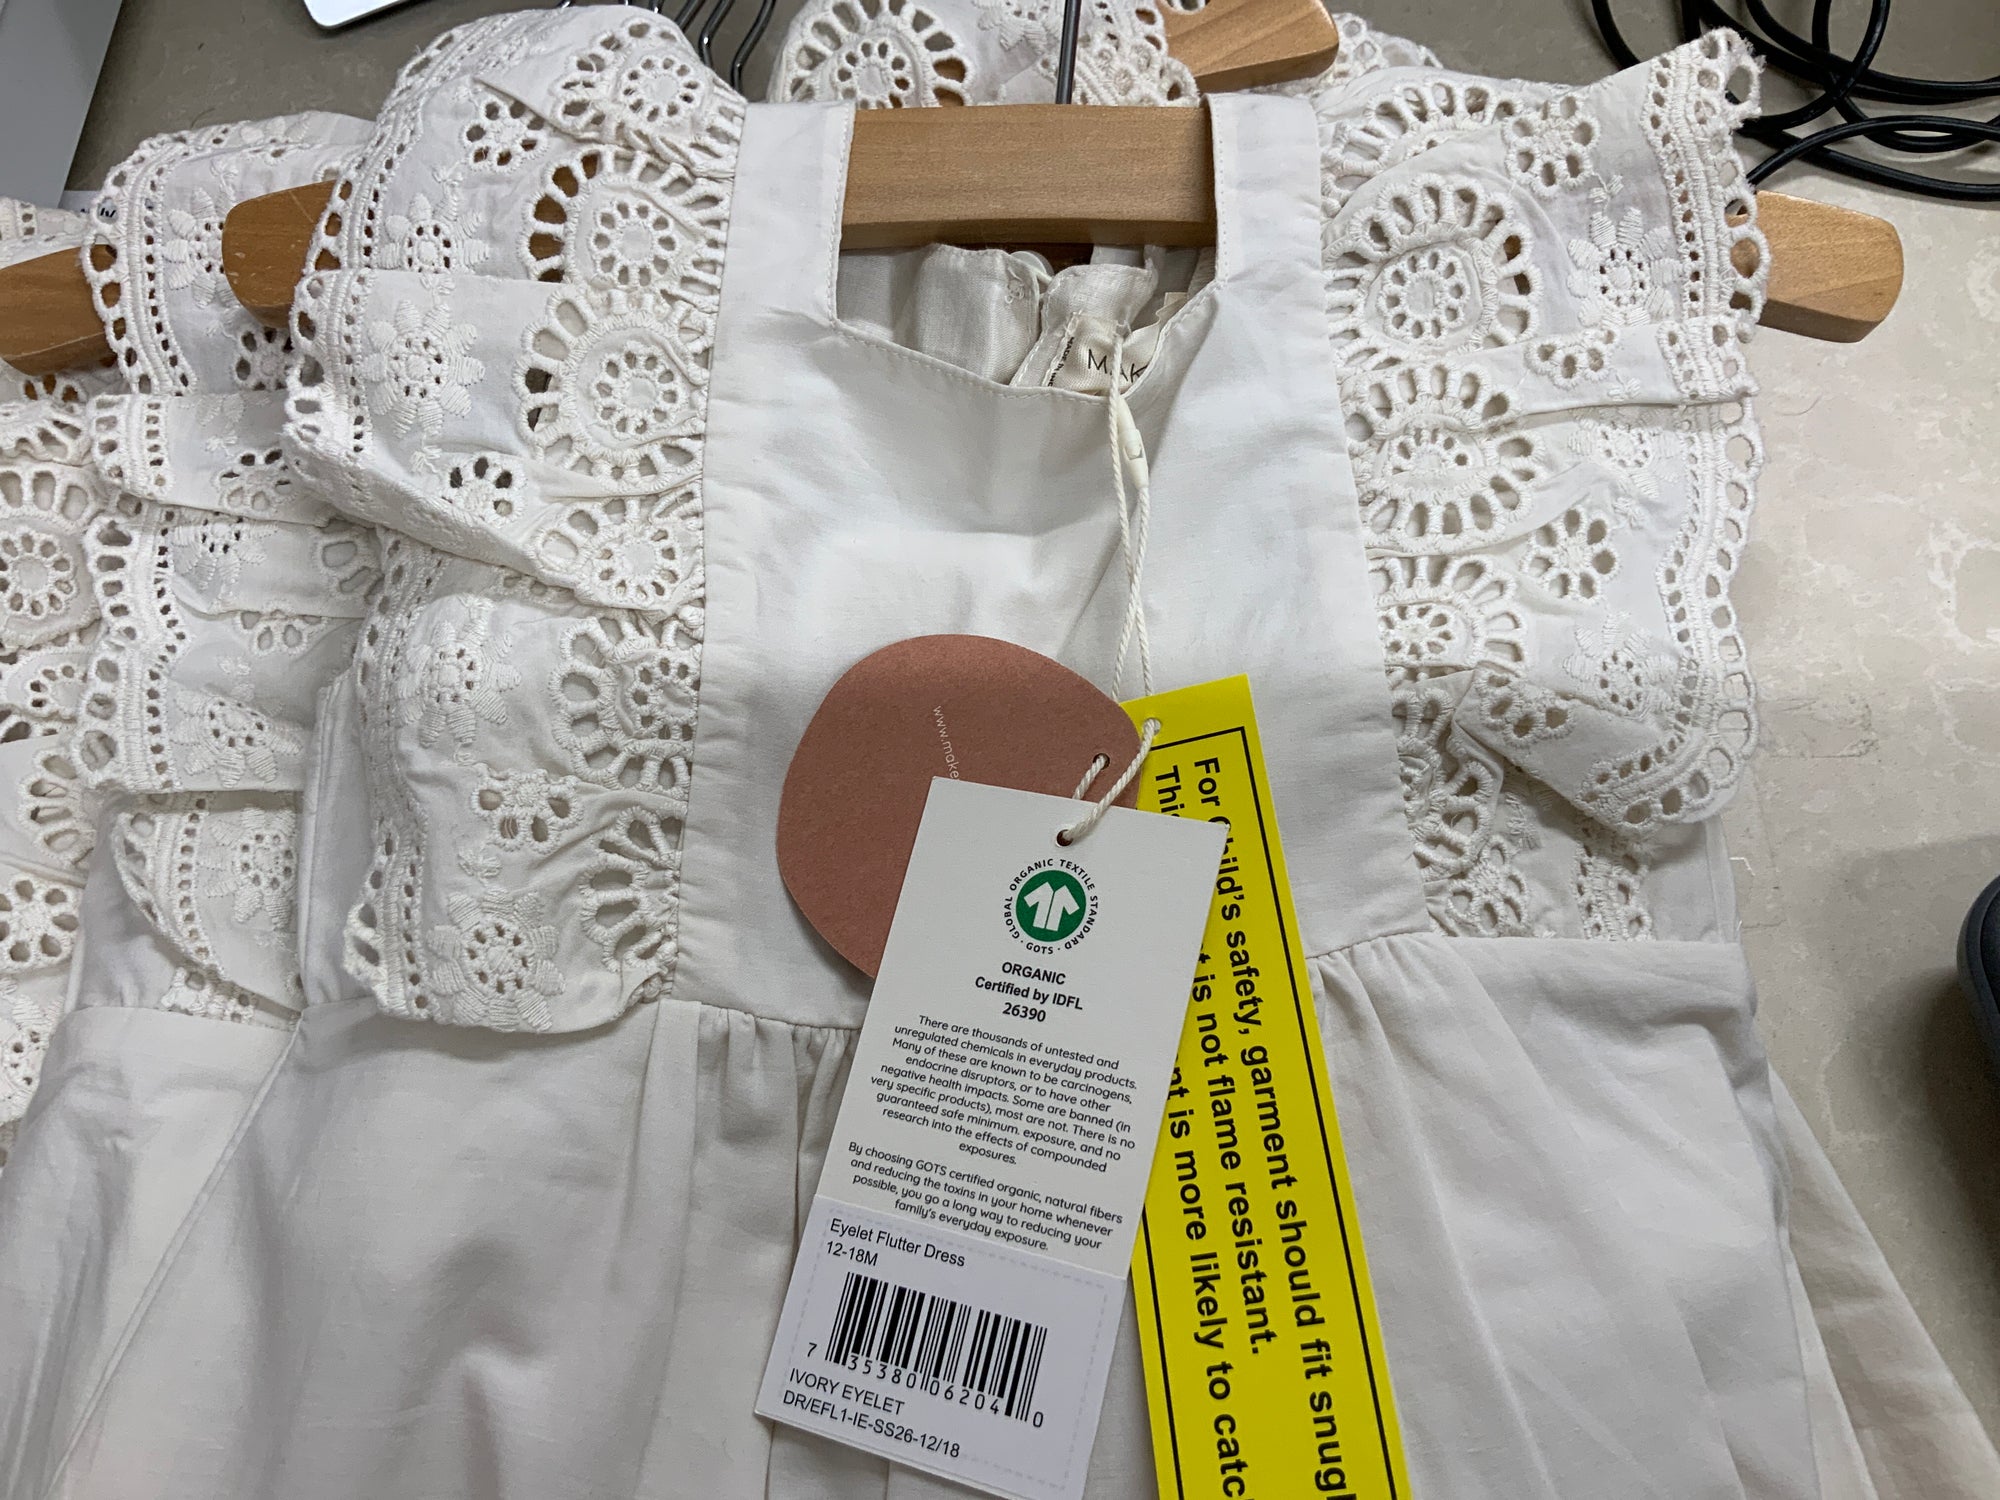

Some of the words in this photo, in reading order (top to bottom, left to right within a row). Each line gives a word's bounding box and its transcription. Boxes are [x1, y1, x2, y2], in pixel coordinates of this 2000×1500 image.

[1155, 765, 1185, 818] Thi
[1194, 757, 1220, 806] For
[1009, 858, 1054, 891] ORGANIC
[1059, 859, 1095, 891] TEXTILE
[1004, 896, 1020, 940] GLOBAL
[1064, 895, 1098, 950] STANDARD
[1001, 960, 1066, 986] ORGANIC
[1026, 941, 1054, 954] GOTS
[974, 975, 1030, 1000] Certified
[1031, 987, 1050, 1006] by
[1051, 991, 1083, 1011] IDFL
[1192, 974, 1216, 1003] is
[1226, 930, 1263, 1035] safety,
[1001, 1001, 1046, 1024] 26390
[1196, 1013, 1229, 1068] not
[891, 1036, 922, 1056] Many
[923, 1045, 937, 1056] of
[937, 1047, 967, 1064] these
[968, 1056, 988, 1069] are
[989, 1059, 1027, 1078] known
[1028, 1069, 1041, 1082] to
[1042, 1071, 1058, 1086] be
[1059, 1078, 1132, 1105] carcinogens,
[893, 1025, 959, 1048] unregulated
[959, 1039, 1014, 1061] chemicals
[1015, 1051, 1027, 1064] in
[1028, 1056, 1082, 1079] everyday
[1083, 1069, 1137, 1091] products.
[918, 1014, 949, 1032] There
[950, 1024, 969, 1036] are
[971, 1027, 1028, 1050] thousands
[1029, 1041, 1043, 1053] of
[1044, 1045, 1095, 1065] untested
[1095, 1057, 1120, 1071] and
[870, 1075, 894, 1092] very
[895, 1082, 936, 1100] specific
[936, 1092, 992, 1115] products),
[994, 1106, 1023, 1122] most
[1025, 1114, 1045, 1128] are
[1046, 1119, 1068, 1134] not.
[1072, 1123, 1105, 1143] There
[1107, 1133, 1117, 1146] is
[1119, 1137, 1135, 1150] no
[879, 1064, 926, 1083] negative
[927, 1073, 962, 1092] health
[963, 1082, 1009, 1104] impacts.
[1011, 1094, 1045, 1112] Some
[1046, 1104, 1067, 1118] are
[1068, 1107, 1114, 1129] banned
[1114, 1120, 1131, 1134] (in
[904, 1055, 958, 1077] endocrine
[959, 1067, 1017, 1092] disruptors,
[1019, 1083, 1033, 1094] or
[1034, 1085, 1047, 1098] to
[1048, 1087, 1077, 1106] have
[1079, 1098, 1111, 1113] other
[875, 1091, 939, 1115] guaranteed
[939, 1108, 965, 1122] safe
[966, 1114, 1020, 1136] minimum.
[1022, 1128, 1077, 1152] exposure,
[1079, 1143, 1104, 1157] and
[1104, 1149, 1121, 1162] no
[881, 1107, 929, 1128] research
[930, 1118, 953, 1134] into
[954, 1124, 973, 1139] the
[974, 1130, 1013, 1150] effects
[1014, 1141, 1029, 1153] of
[1029, 1145, 1107, 1174] compounded
[1168, 1109, 1195, 1139] is
[1207, 1075, 1242, 1170] flame
[1240, 1045, 1298, 1190] garment
[847, 1140, 863, 1157] By
[864, 1146, 913, 1170] choosing
[914, 1158, 947, 1177] GOTS
[948, 1169, 995, 1190] certified
[995, 1182, 1042, 1205] organic,
[1044, 1195, 1087, 1215] natural
[1089, 1204, 1123, 1225] fibers
[958, 1142, 1016, 1166] exposures.
[849, 1158, 872, 1172] and
[872, 1164, 921, 1187] reducing
[922, 1176, 941, 1191] the
[943, 1181, 976, 1200] toxins
[977, 1190, 988, 1203] in
[990, 1196, 1018, 1211] your
[1018, 1201, 1053, 1221] home
[1055, 1213, 1113, 1237] whenever
[851, 1174, 898, 1196] possible,
[900, 1187, 922, 1201] you
[923, 1193, 940, 1206] go
[941, 1198, 950, 1209] a
[951, 1198, 977, 1218] long
[979, 1208, 1004, 1226] way
[1005, 1214, 1018, 1227] to
[1020, 1220, 1072, 1244] reducing
[1073, 1234, 1102, 1250] your
[1174, 1151, 1207, 1240] more
[830, 1217, 874, 1242] Eyelet
[876, 1229, 922, 1254] Flutter
[924, 1242, 965, 1267] Dress
[894, 1198, 936, 1220] family's
[937, 1212, 992, 1238] everyday
[993, 1228, 1048, 1251] exposure.
[827, 1240, 878, 1267] 12-18M
[1225, 1182, 1278, 1354] resistant.
[1275, 1200, 1326, 1328] should
[1190, 1252, 1228, 1349] likely
[806, 1342, 818, 1358] 7
[1033, 1411, 1044, 1428] 0
[1206, 1361, 1234, 1400] to
[1300, 1338, 1333, 1380] fit
[789, 1367, 840, 1395] IVORY
[841, 1383, 905, 1415] EYELET
[783, 1388, 960, 1458] DR/EFL1-IE-SS26-12/18
[1213, 1413, 1254, 1500] catc
